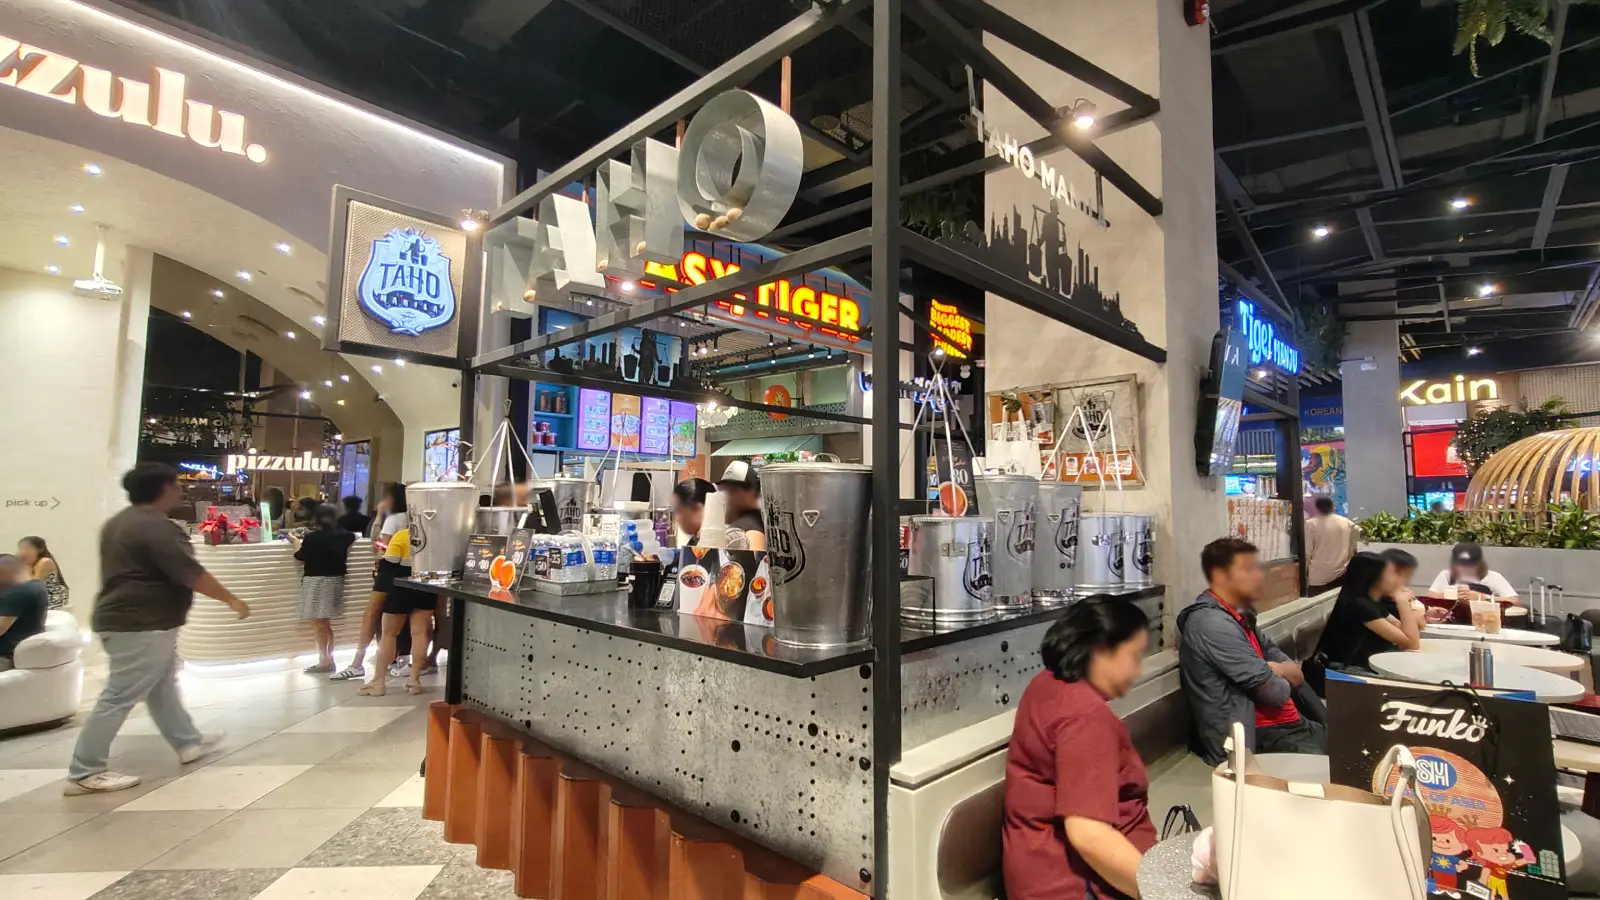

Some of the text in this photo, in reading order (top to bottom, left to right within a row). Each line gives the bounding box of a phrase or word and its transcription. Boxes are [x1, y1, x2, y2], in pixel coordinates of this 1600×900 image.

[380, 263, 440, 299] TAHO
[754, 278, 861, 342] TIGER
[226, 447, 336, 475] pizzulu.
[6, 499, 31, 508] pick
[1380, 701, 1487, 743] Funko
[1416, 758, 1450, 787] SM
